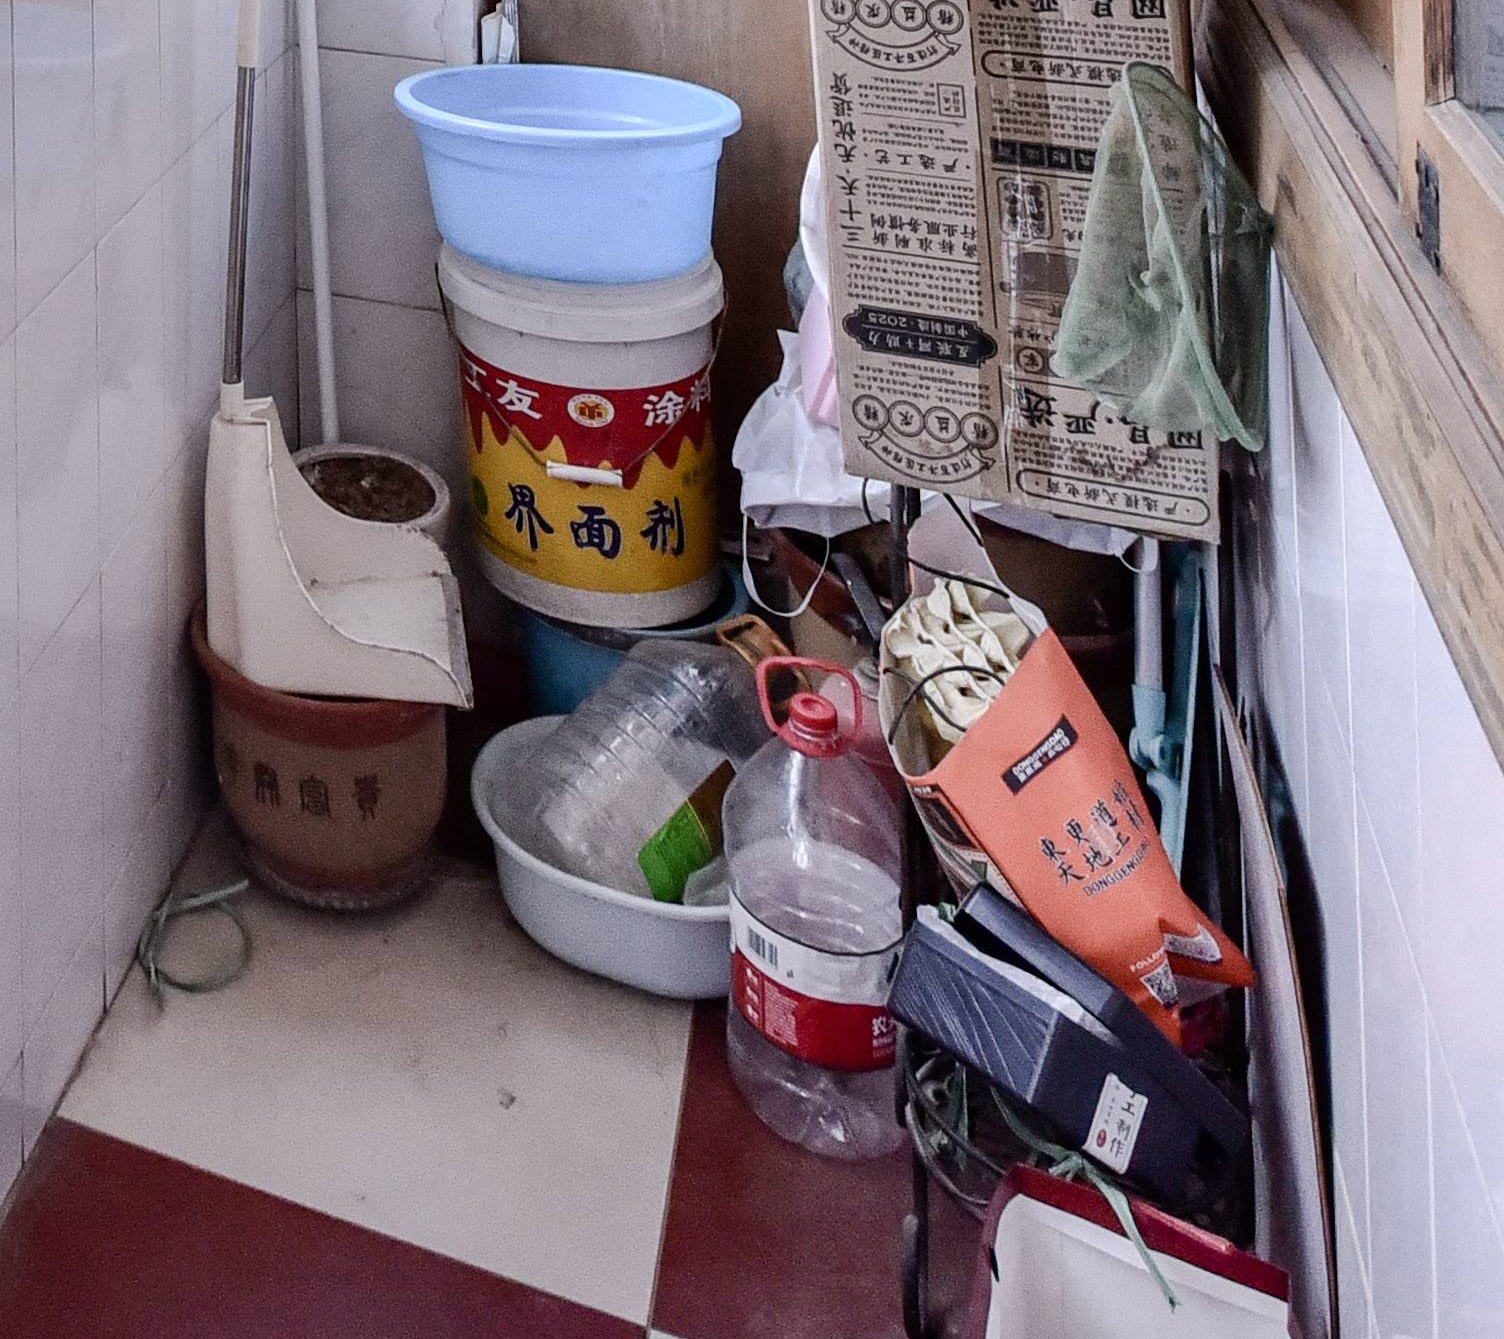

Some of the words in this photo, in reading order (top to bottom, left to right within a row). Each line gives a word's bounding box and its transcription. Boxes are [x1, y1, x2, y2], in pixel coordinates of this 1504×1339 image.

[830, 0, 954, 26] 精益求精
[870, 213, 976, 239] 行业服务惯例
[872, 231, 977, 258] 高标准刷新
[862, 404, 989, 440] 精益求精
[504, 482, 687, 560] 界面剂
[1109, 1092, 1136, 1158] 工制作
